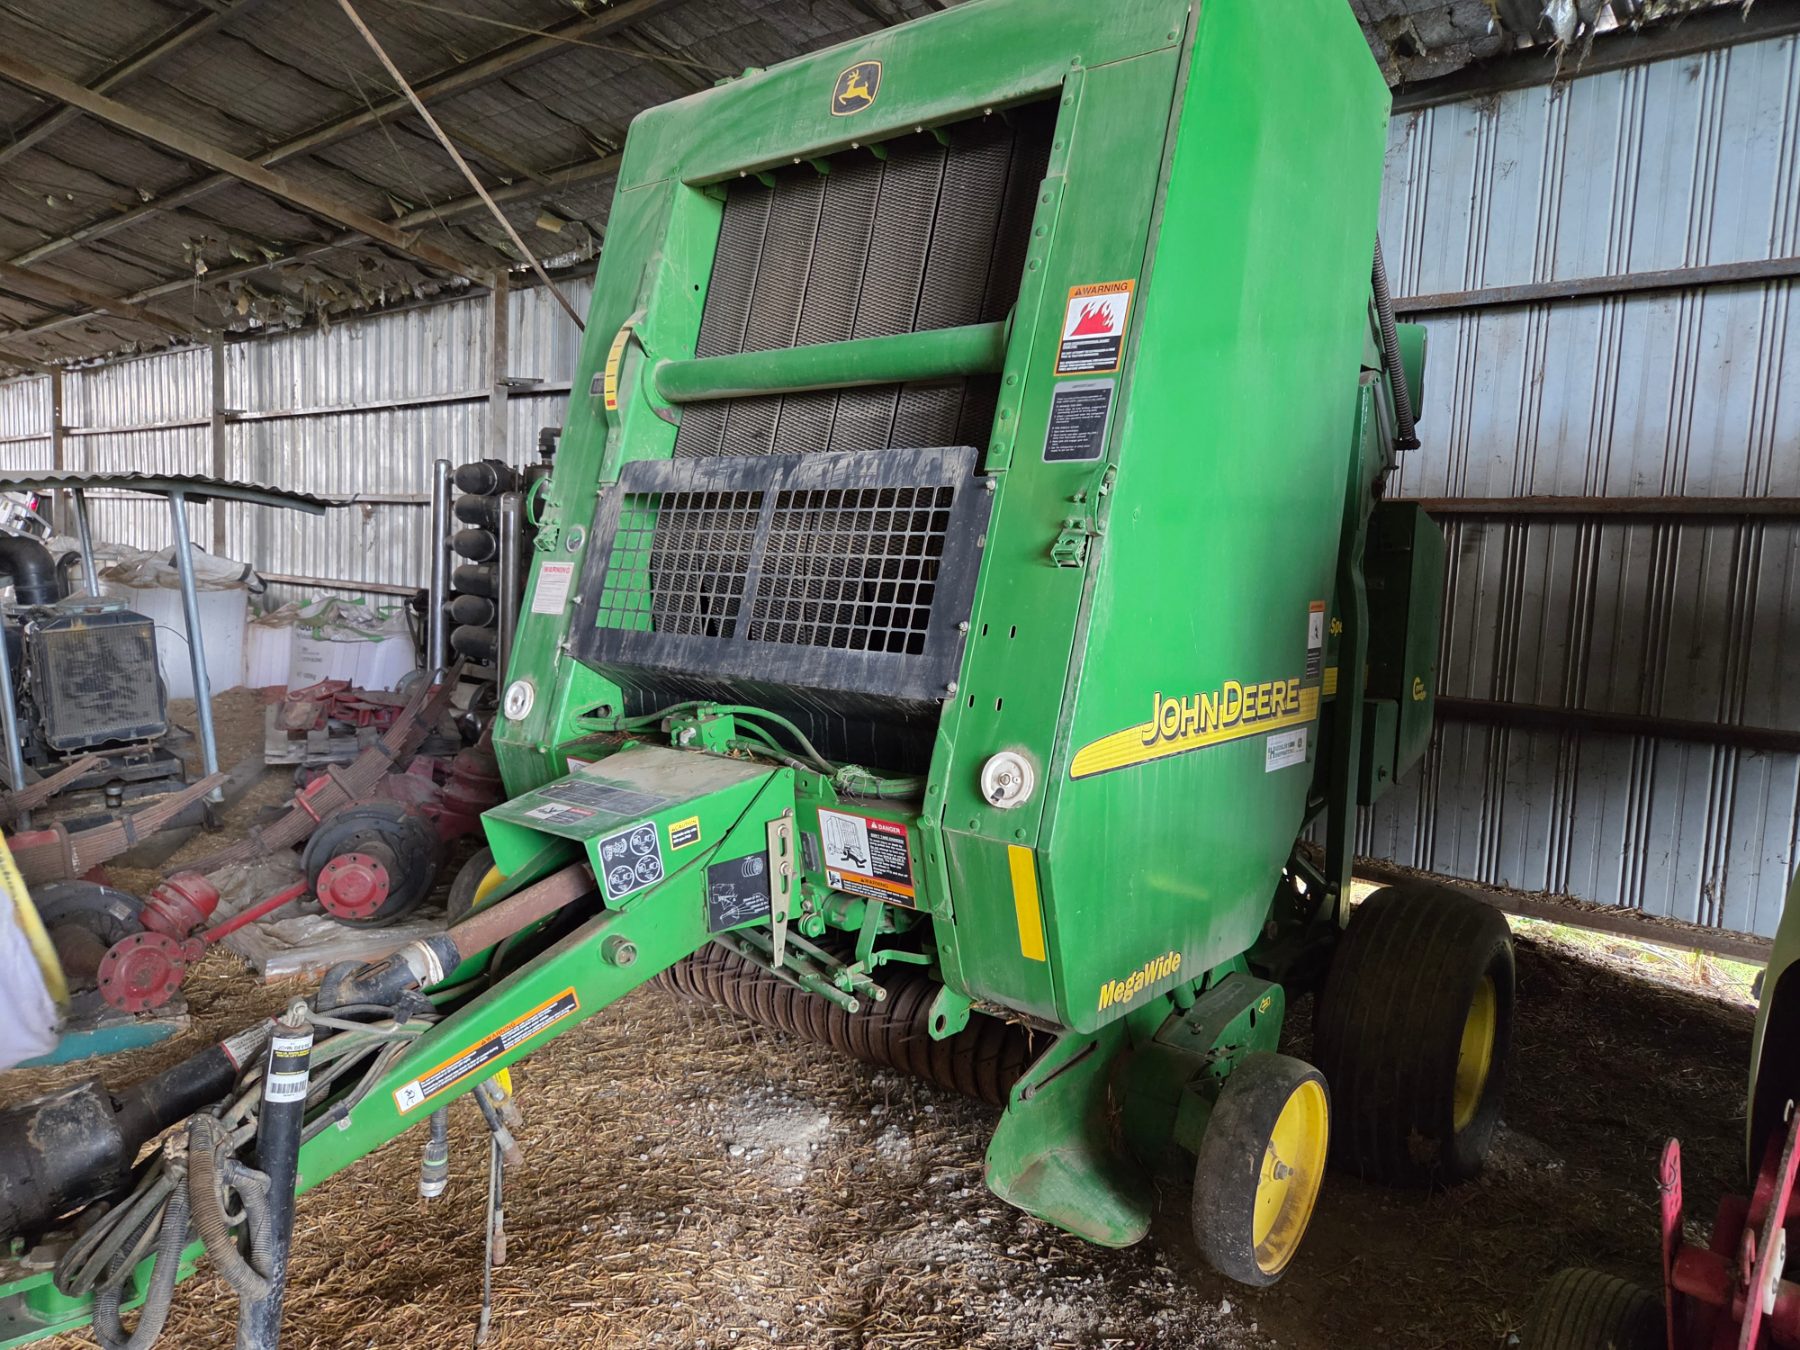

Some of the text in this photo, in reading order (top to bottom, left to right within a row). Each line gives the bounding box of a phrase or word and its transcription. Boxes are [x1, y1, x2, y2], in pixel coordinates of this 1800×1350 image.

[1081, 282, 1128, 296] WARNING
[544, 566, 571, 574] WARNING
[1141, 678, 1301, 746] JOHN DEERE
[877, 824, 901, 834] DANGER
[1098, 951, 1182, 1012] MegaWide
[485, 1022, 516, 1041] WARNING
